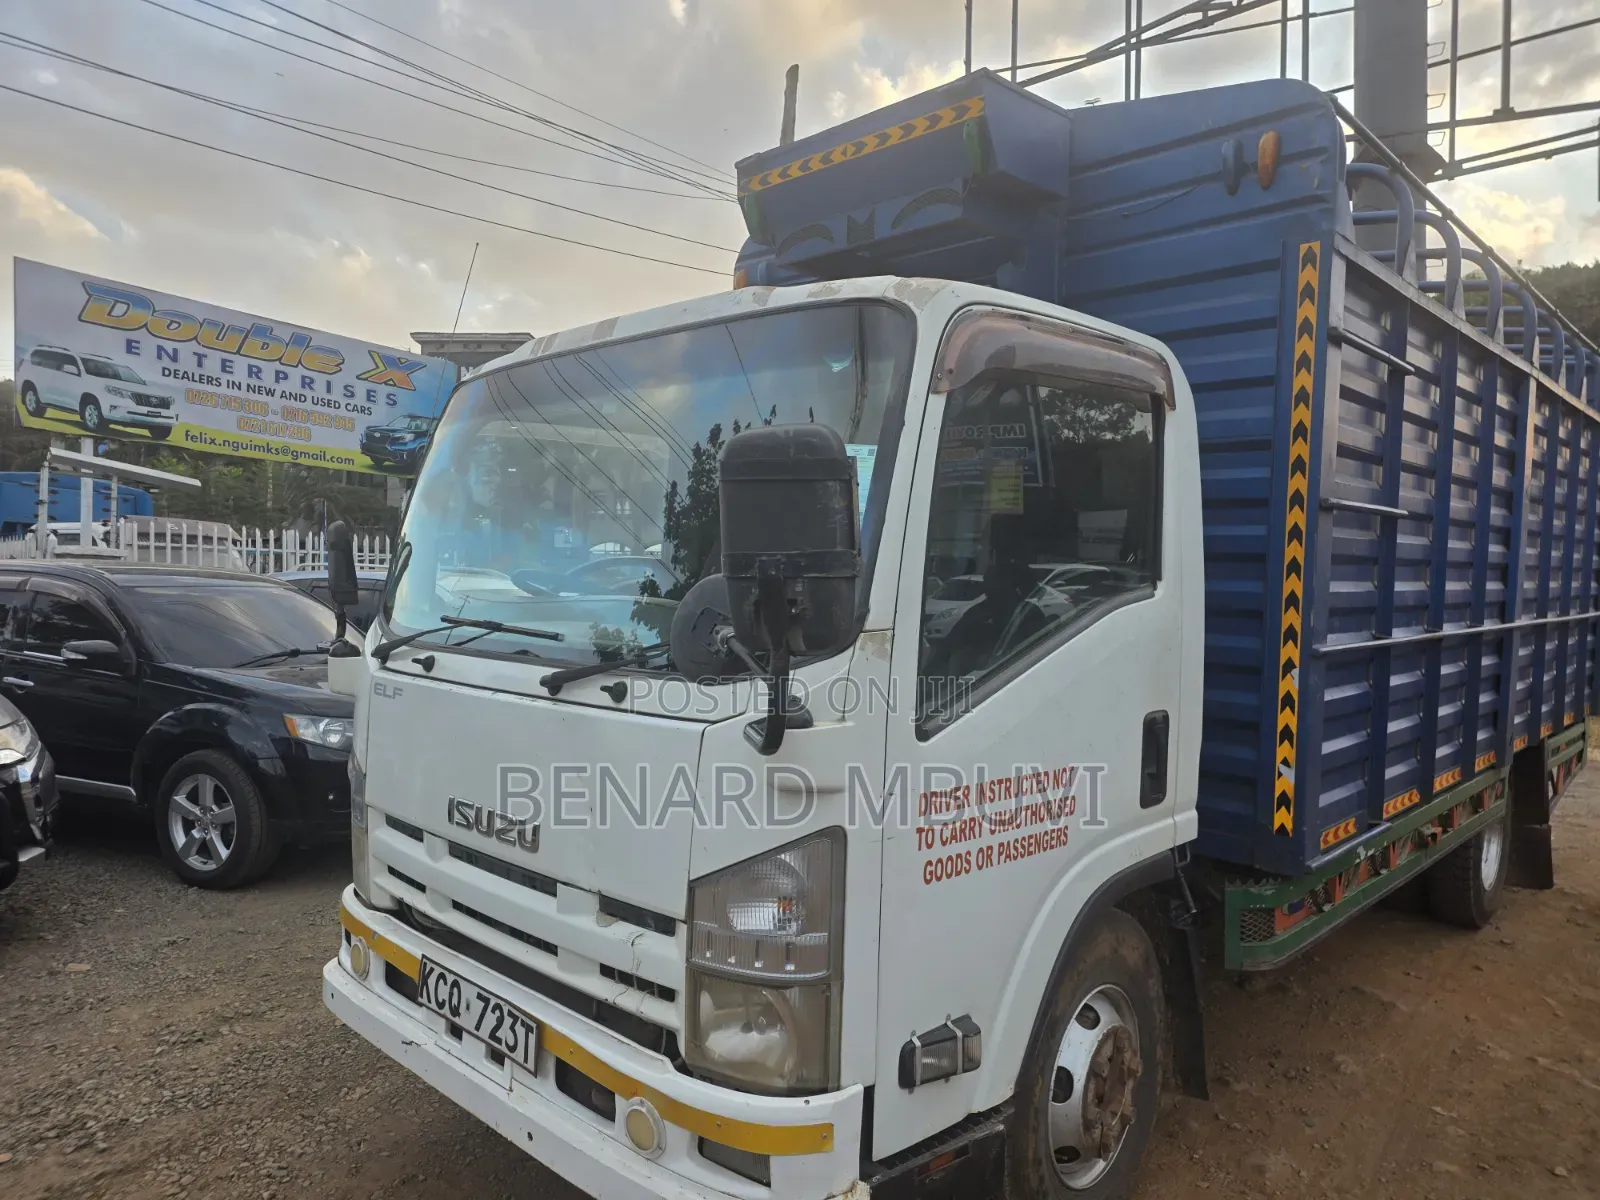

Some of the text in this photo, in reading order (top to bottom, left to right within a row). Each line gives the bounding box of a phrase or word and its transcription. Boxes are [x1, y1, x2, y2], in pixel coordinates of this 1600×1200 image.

[78, 281, 427, 391] Double X
[126, 338, 398, 407] ENTERPRISES
[162, 367, 373, 416] DEALERS IN NEW AND USED CARS
[185, 388, 218, 409] 0726
[243, 398, 269, 417] 306
[184, 429, 355, 466] felix.nguimks@gmail.com
[373, 682, 405, 701] ELF
[918, 766, 1075, 817] DRIVER INSTRUCTED NOT
[447, 794, 541, 854] ISUZU
[916, 795, 1076, 851] TO CARRY UNAUTHORISED
[923, 825, 1069, 885] GOODS OR PASSENGERS
[419, 961, 535, 1065] KCQ 723T
